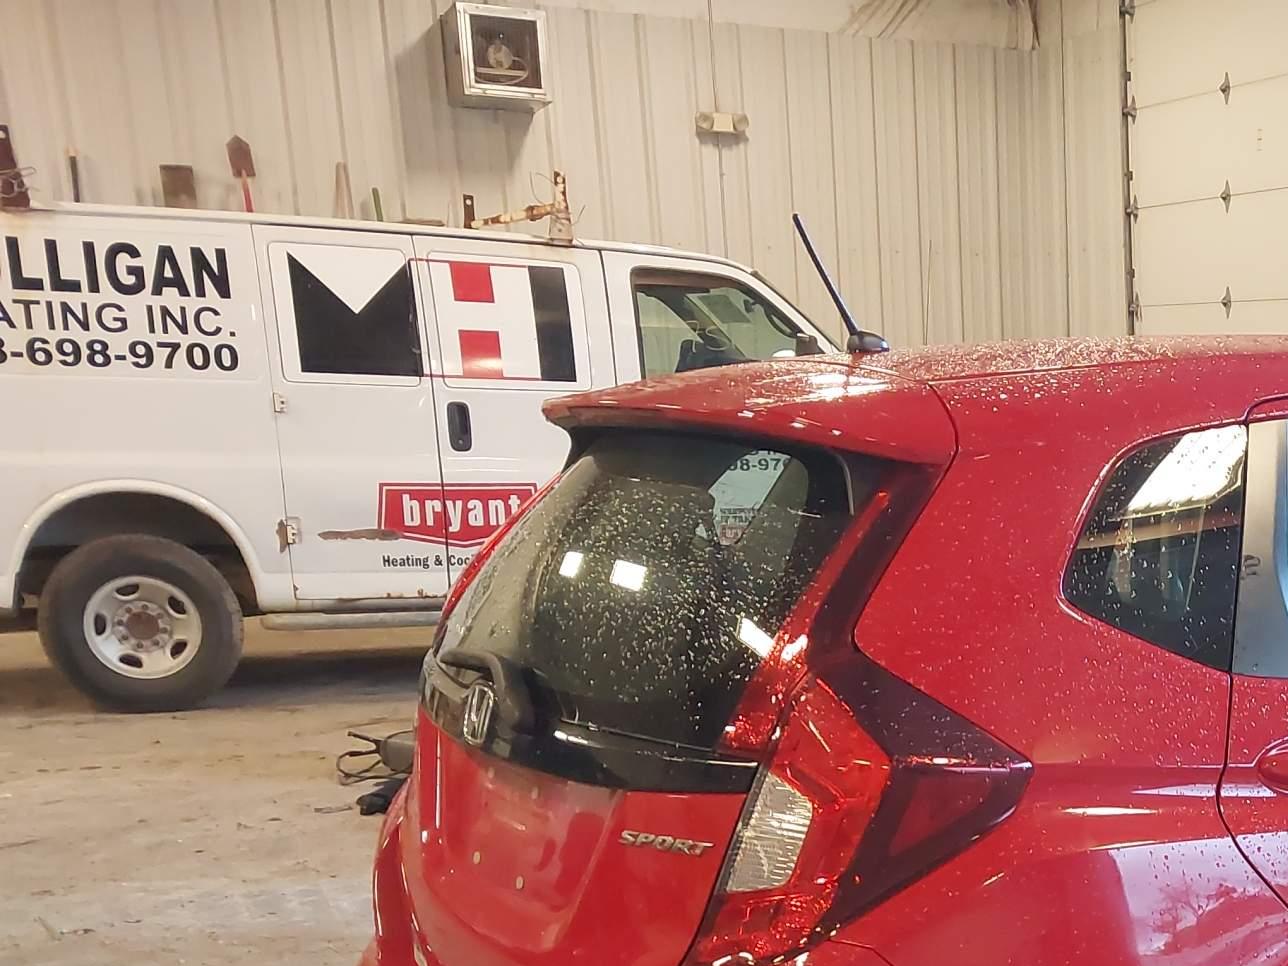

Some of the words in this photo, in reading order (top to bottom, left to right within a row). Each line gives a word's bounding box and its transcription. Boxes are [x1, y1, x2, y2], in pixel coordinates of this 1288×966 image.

[145, 304, 237, 338] INC.
[401, 493, 521, 533] bryant
[382, 554, 430, 570] Heating
[433, 554, 443, 567] &
[618, 829, 715, 857] SPORT
